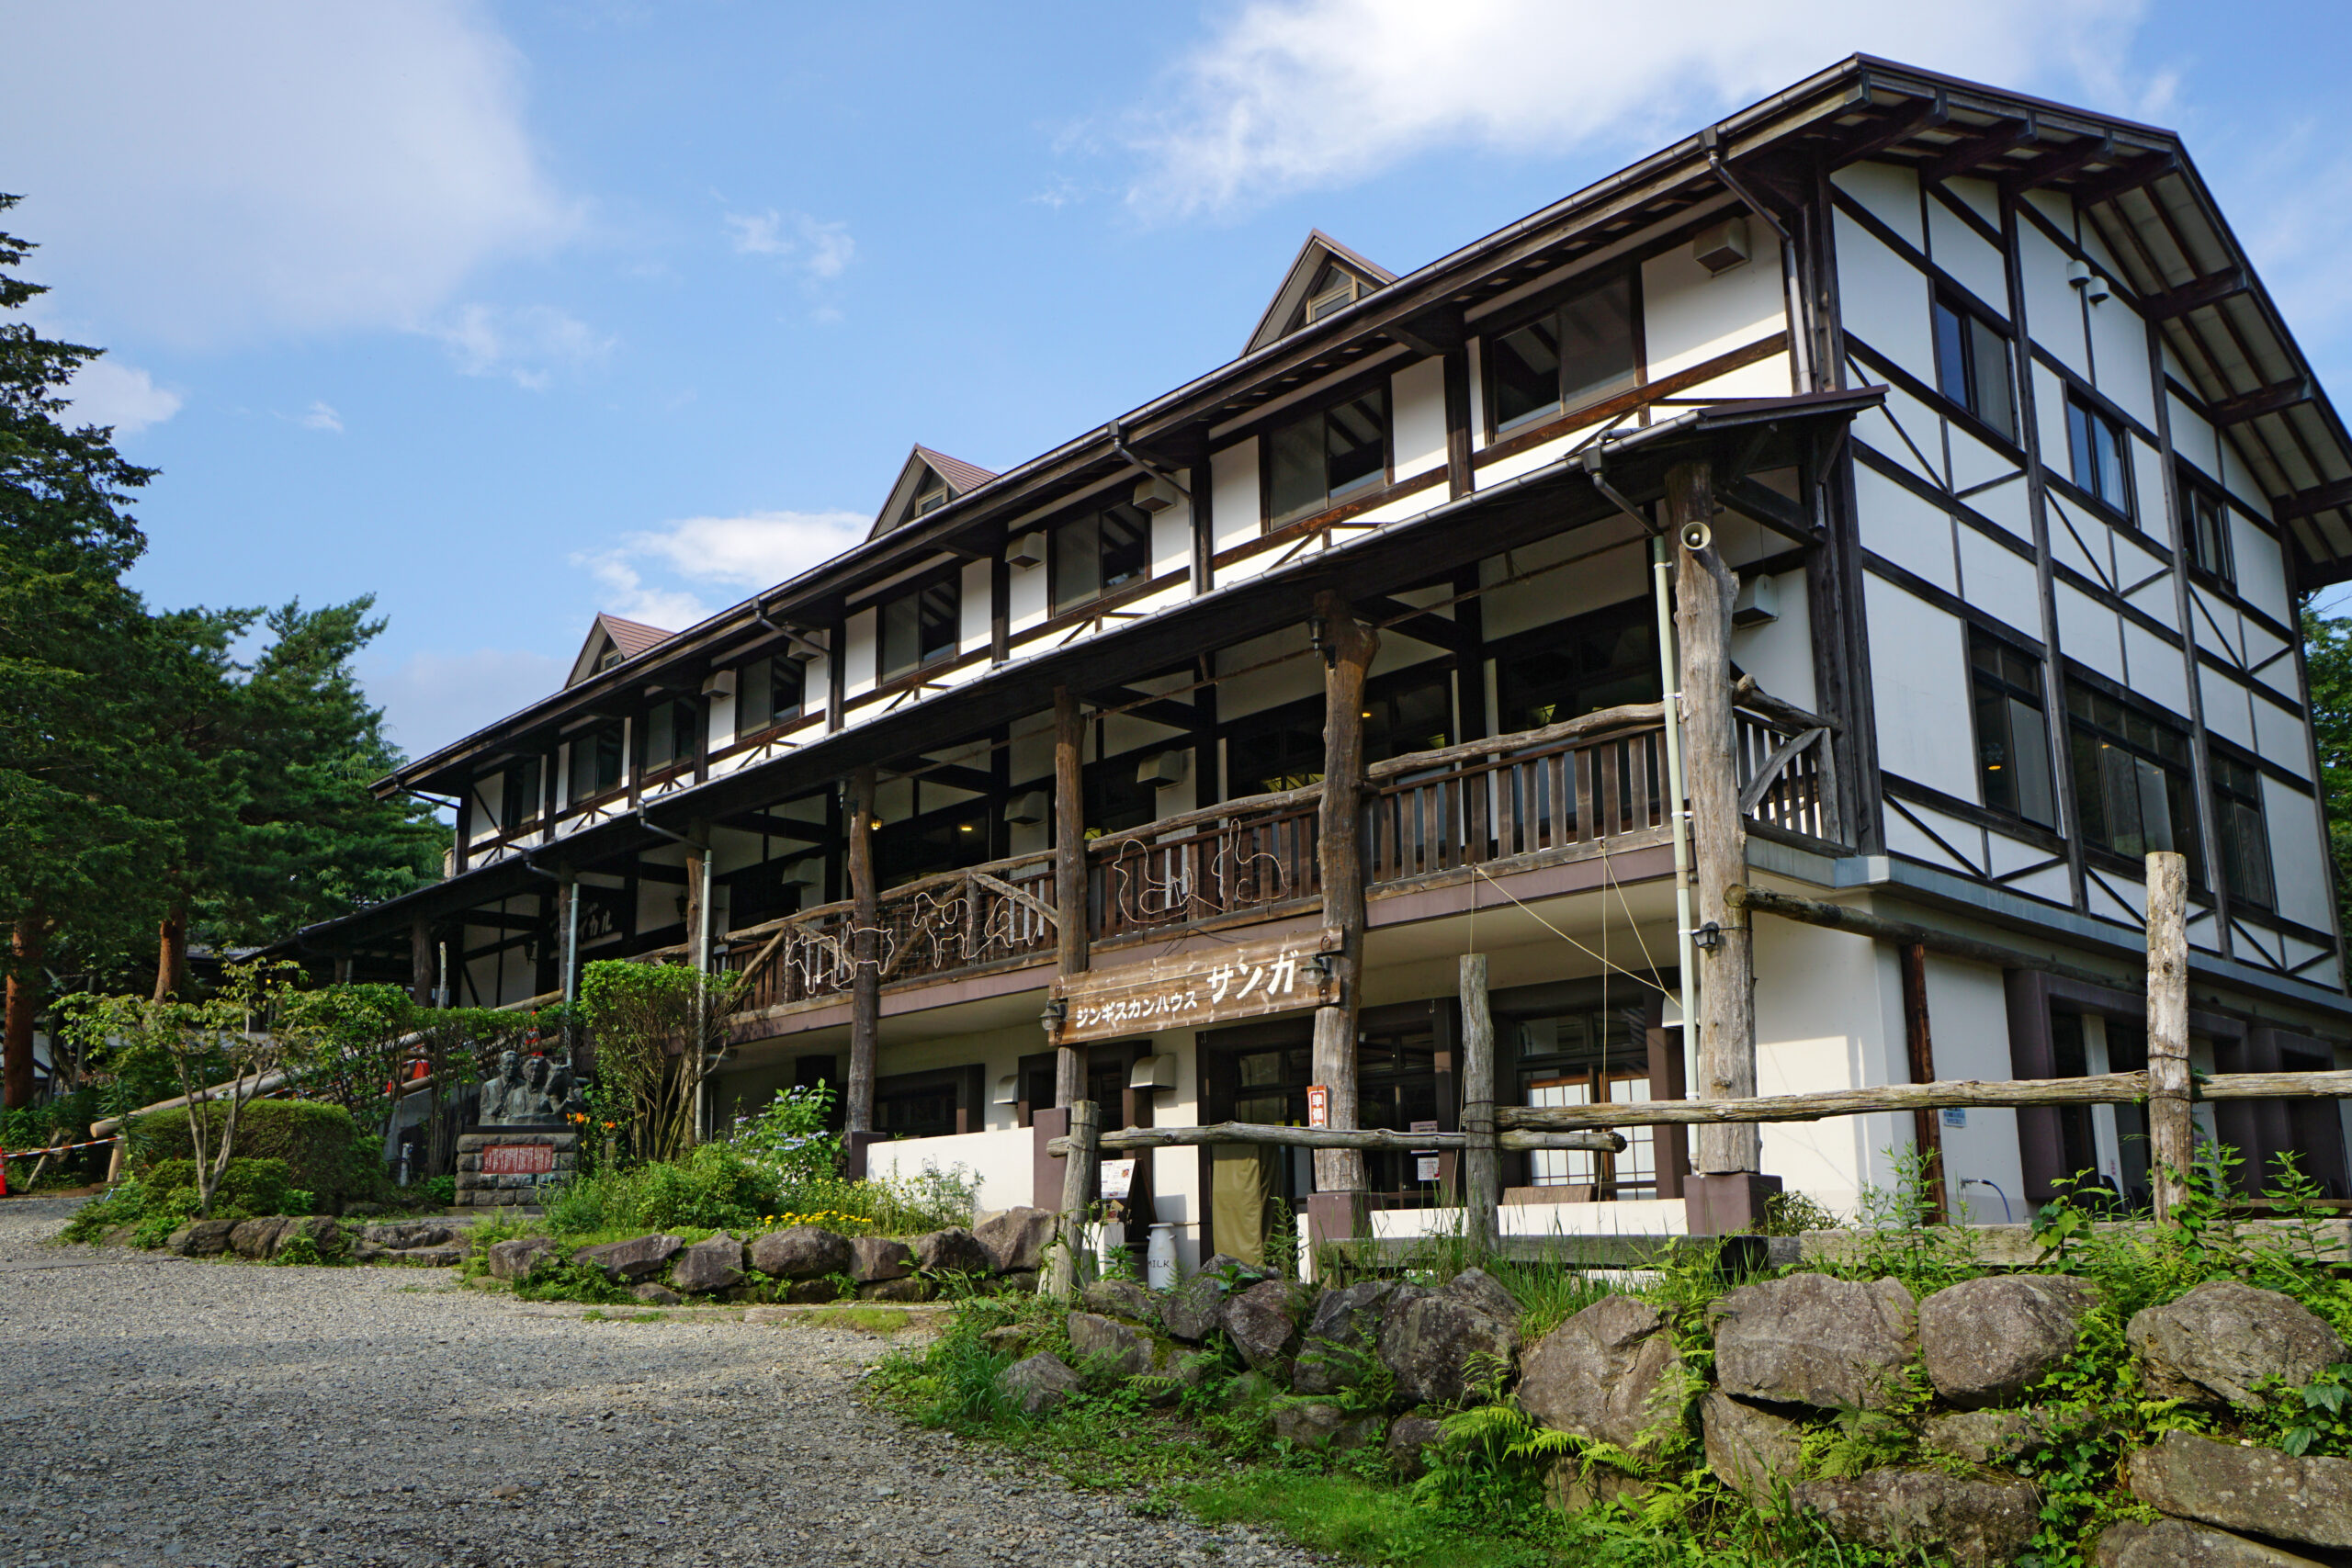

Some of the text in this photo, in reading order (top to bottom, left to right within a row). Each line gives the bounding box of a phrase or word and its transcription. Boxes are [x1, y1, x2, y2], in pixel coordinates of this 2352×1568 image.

[1076, 949, 1299, 1028] ジンギスカンハウス サンガ
